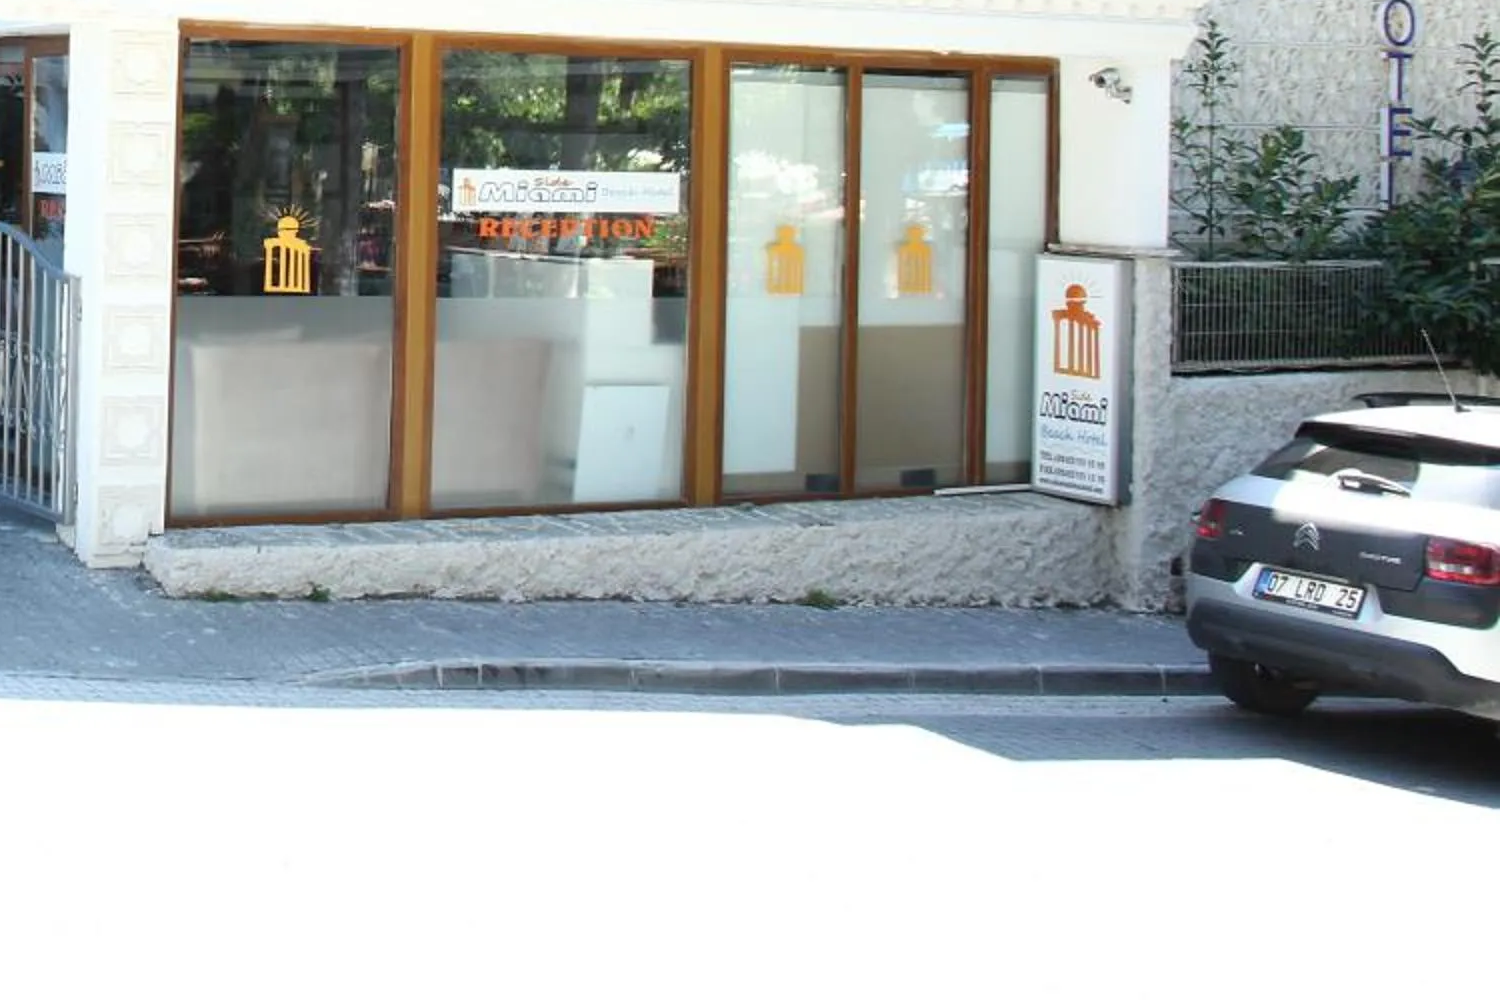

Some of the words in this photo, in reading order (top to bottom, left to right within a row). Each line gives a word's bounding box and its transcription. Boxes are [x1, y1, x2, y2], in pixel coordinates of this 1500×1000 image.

[478, 181, 599, 203] Miami
[478, 213, 657, 240] RECEPTION
[1040, 391, 1108, 425] Miami
[1267, 573, 1289, 593] 07
[1335, 588, 1359, 609] 25
